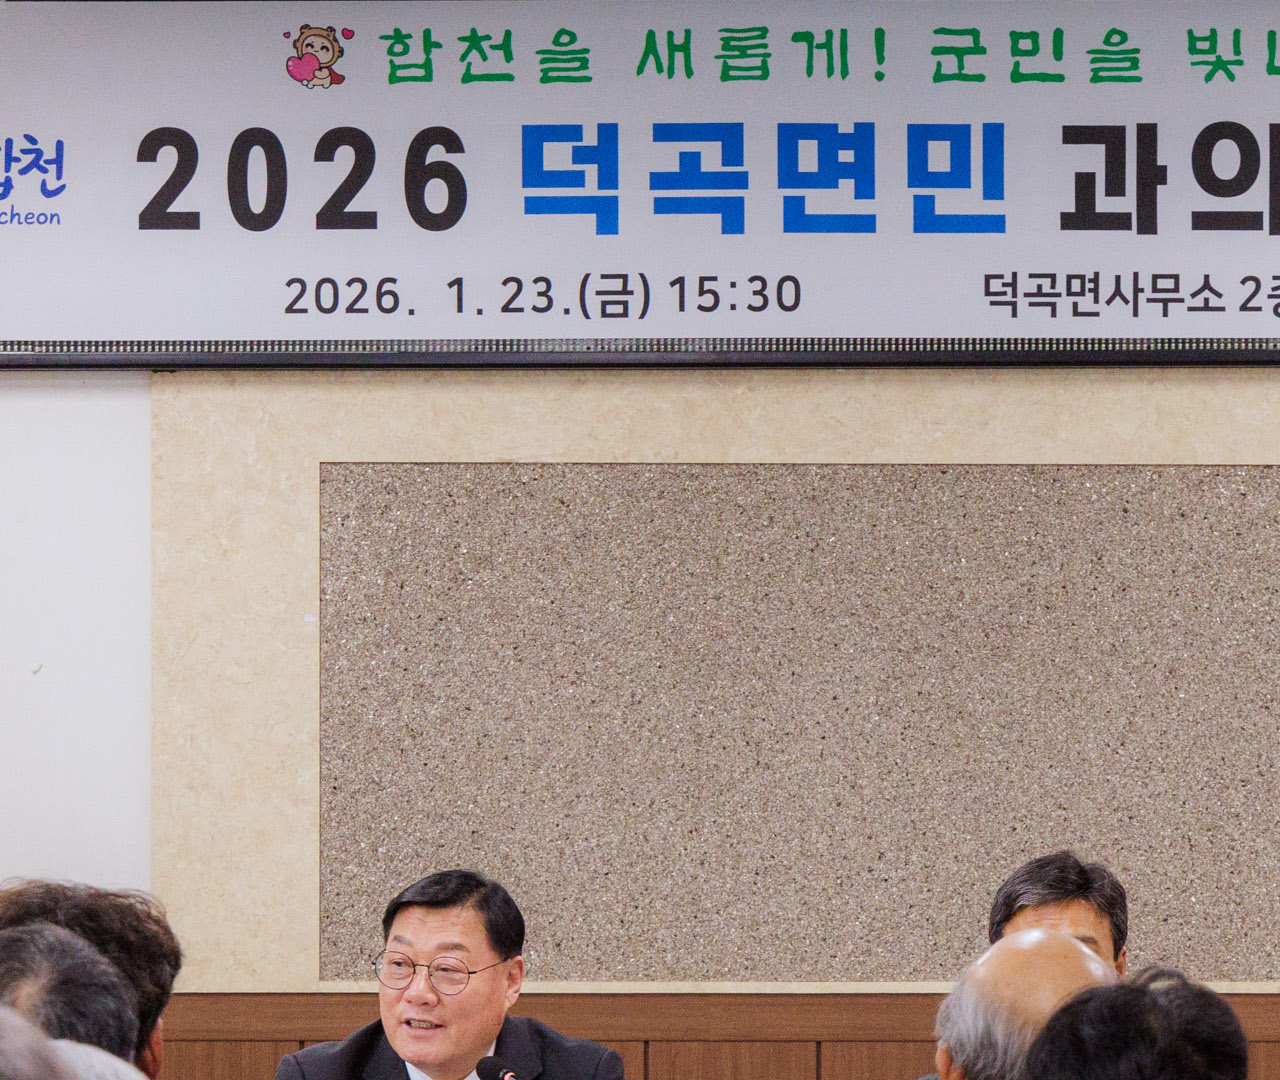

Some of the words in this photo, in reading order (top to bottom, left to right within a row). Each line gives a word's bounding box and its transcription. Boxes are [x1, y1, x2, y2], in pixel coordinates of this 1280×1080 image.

[380, 29, 593, 85] 합천을
[637, 27, 886, 83] 새롭게!
[932, 28, 1143, 84] 군민을
[138, 127, 468, 232] 2026
[523, 123, 1007, 236] 덕곡면민
[286, 278, 415, 316] 2026.
[448, 278, 484, 316] 1.
[671, 276, 801, 313] 15:30
[985, 273, 1226, 319] 덕곡면사무소
